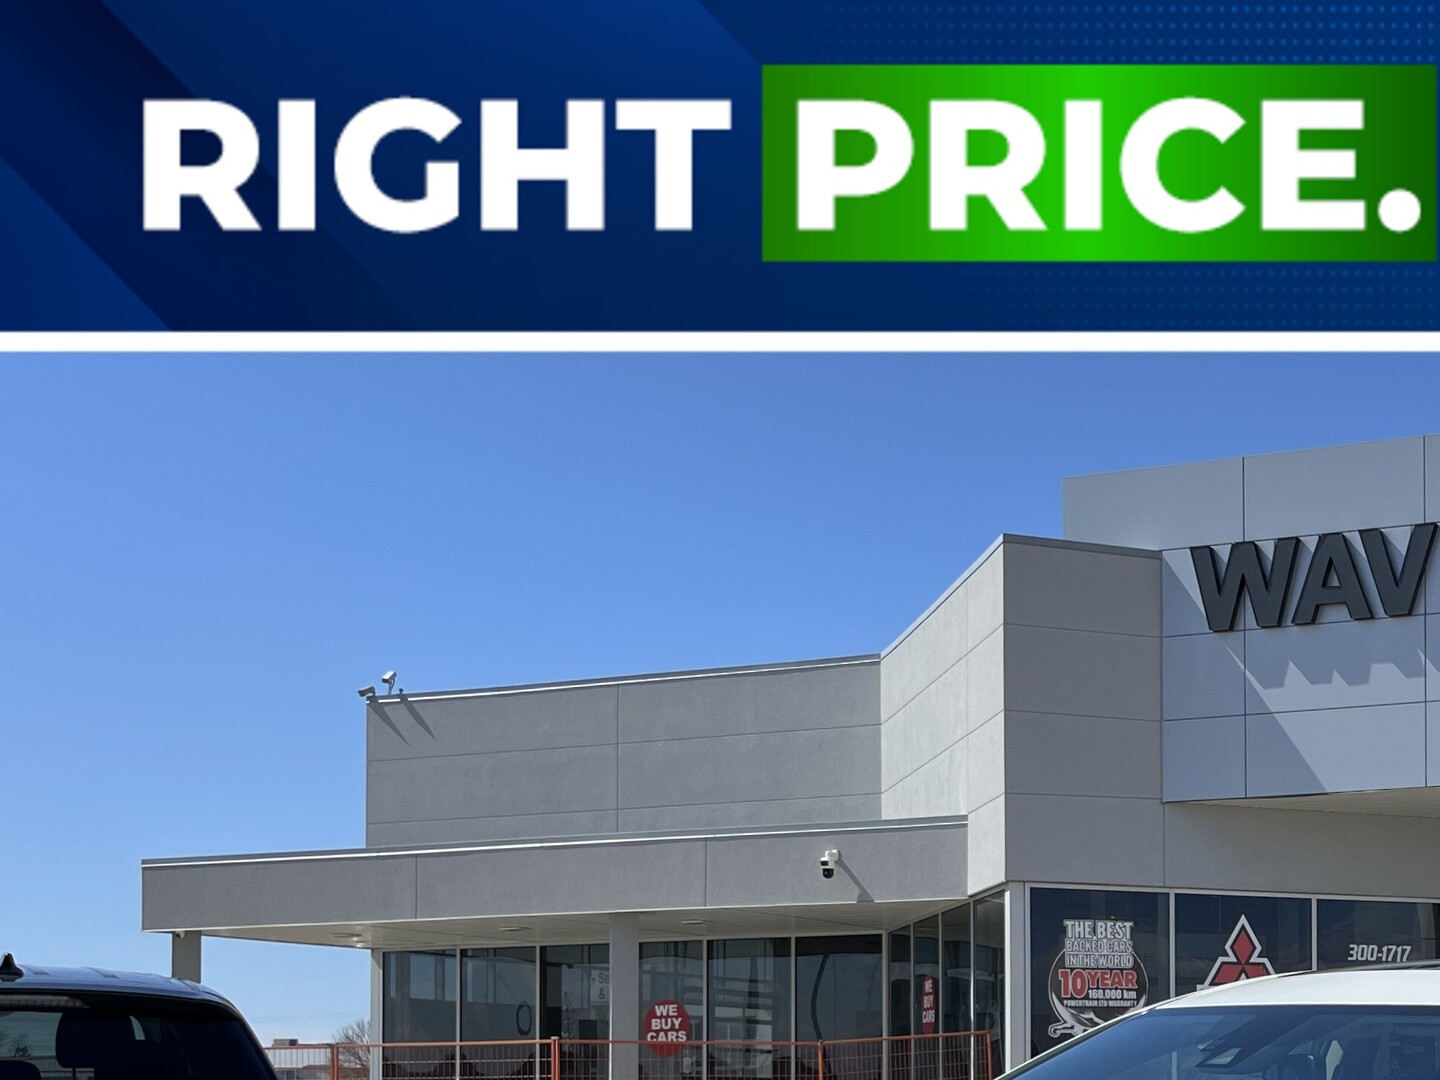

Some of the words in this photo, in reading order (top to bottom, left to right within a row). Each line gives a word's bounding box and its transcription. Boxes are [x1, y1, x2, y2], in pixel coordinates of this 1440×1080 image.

[1064, 920, 1093, 939] THE
[1096, 920, 1133, 939] BEST
[1066, 940, 1104, 952] BACKED
[1107, 941, 1133, 953] CARS
[1348, 944, 1411, 962] 300-1717
[1066, 954, 1076, 966] IN
[1078, 954, 1097, 966] THE
[1099, 954, 1133, 967] WORLD
[1059, 969, 1088, 998] 10
[1087, 970, 1138, 989] YEAR
[1088, 989, 1121, 999] 160,000
[1123, 989, 1137, 999] km
[655, 1004, 678, 1016] WE
[651, 1018, 682, 1030] BUY
[647, 1031, 687, 1042] CARS
